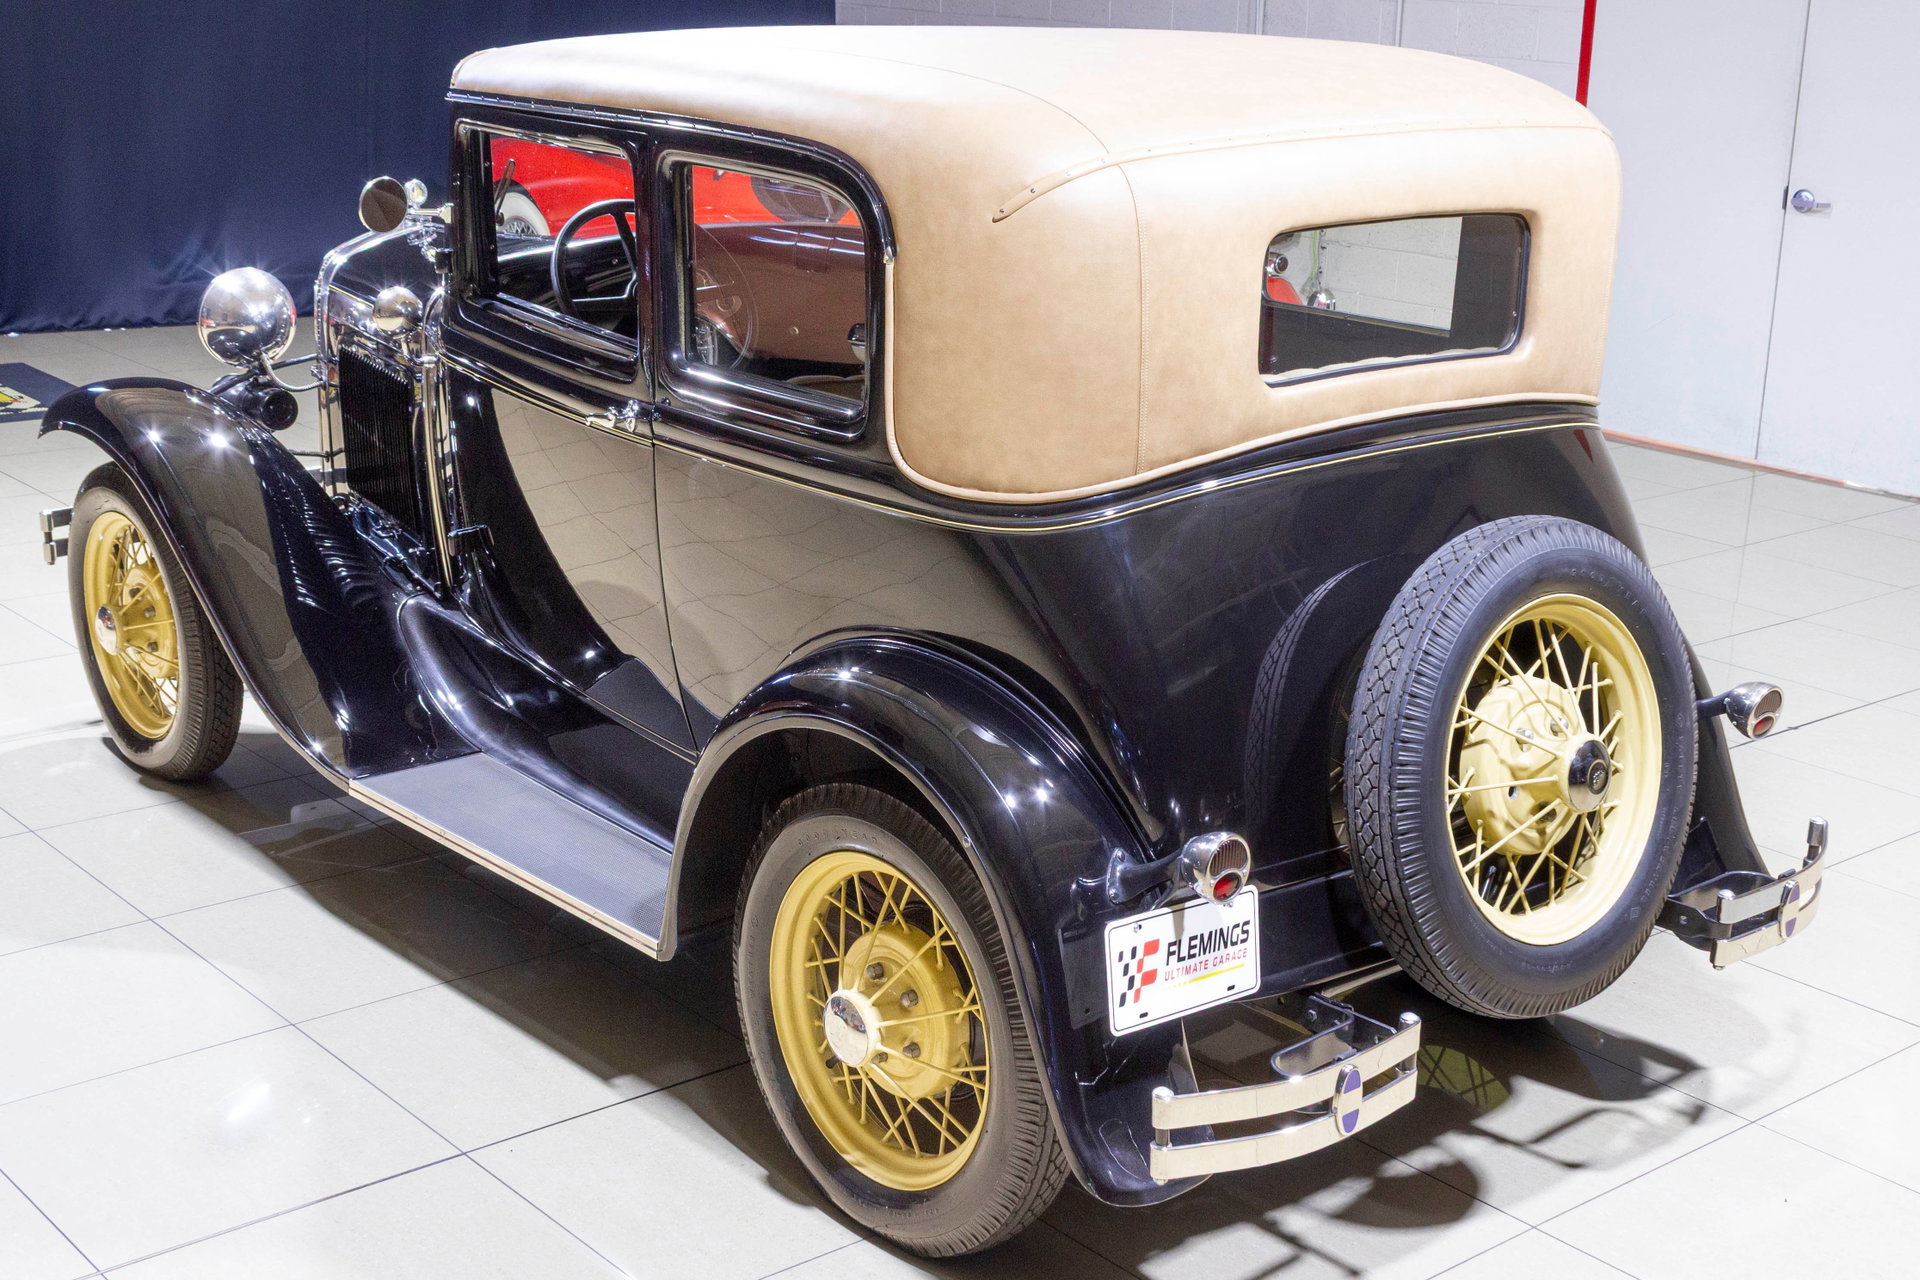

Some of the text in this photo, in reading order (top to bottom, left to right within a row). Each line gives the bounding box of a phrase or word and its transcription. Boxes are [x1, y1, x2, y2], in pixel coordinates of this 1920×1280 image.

[1166, 920, 1250, 966] FLEMINGS
[1164, 948, 1248, 981] ULTIMATE GARAGE
